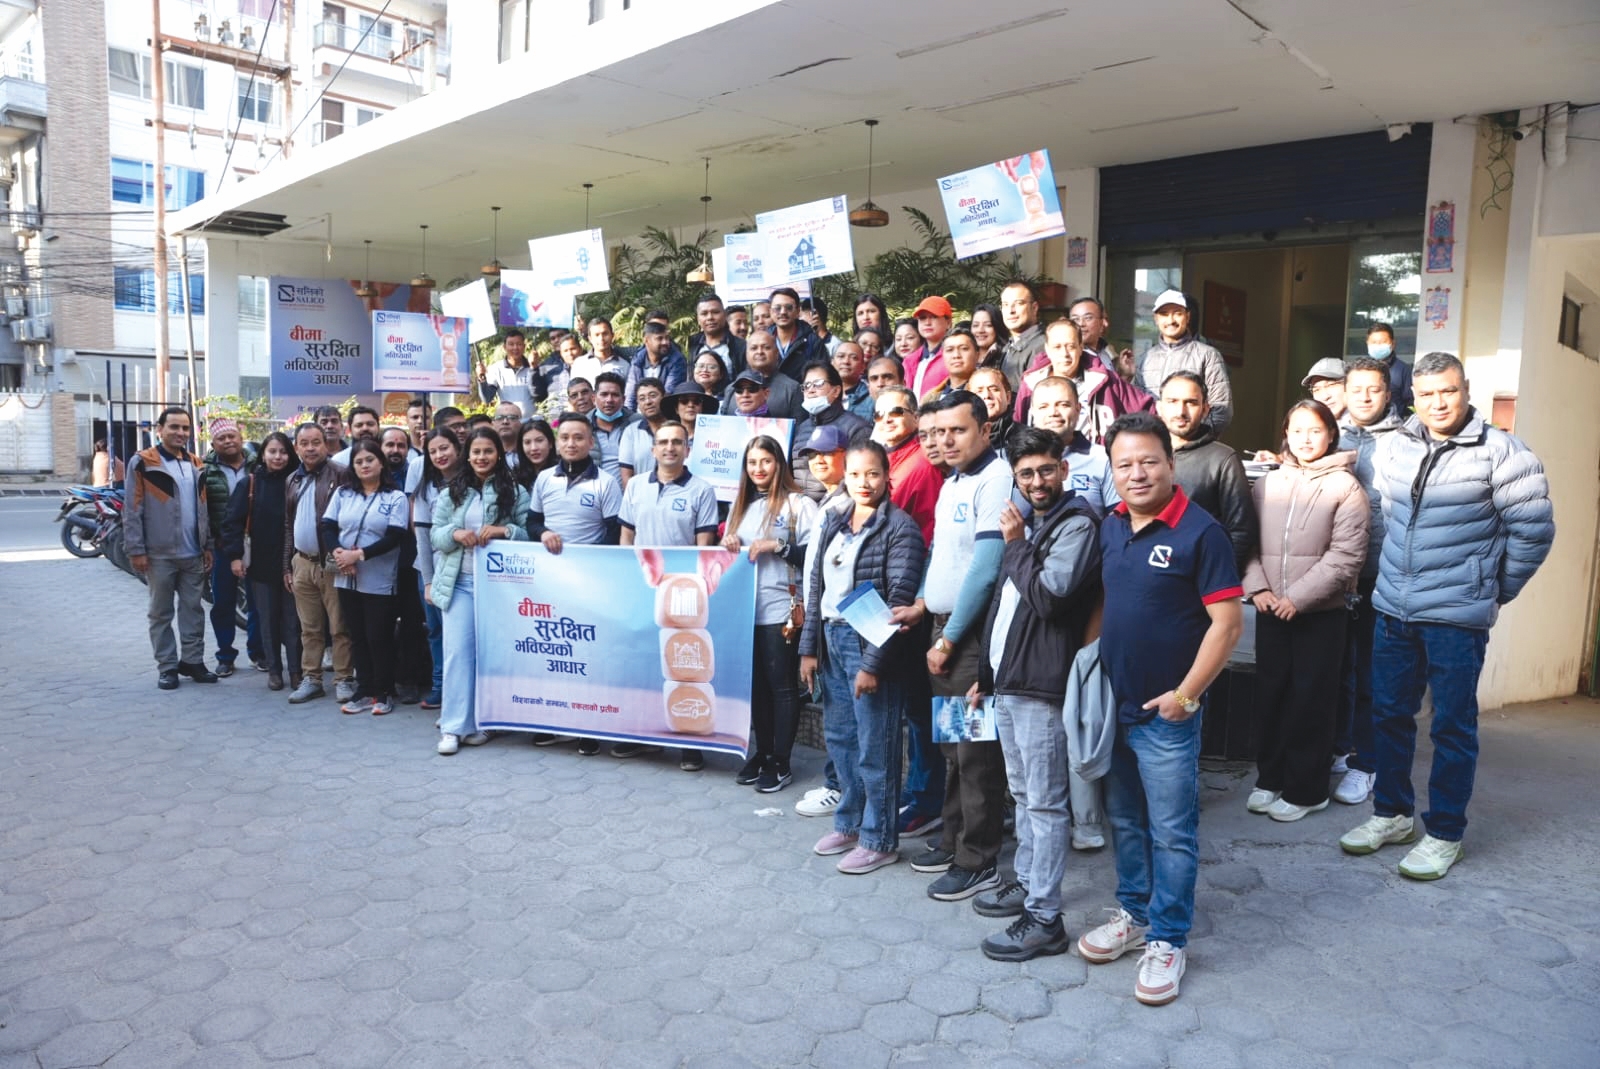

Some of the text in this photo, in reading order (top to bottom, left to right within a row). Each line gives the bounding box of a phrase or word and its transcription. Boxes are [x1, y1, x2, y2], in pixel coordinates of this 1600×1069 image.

[304, 339, 361, 360] सुरक्षित
[284, 357, 339, 371] भविष्यको
[534, 616, 596, 642] सुरक्षित
[515, 636, 573, 657] भविष्यको
[546, 659, 587, 677] आधार
